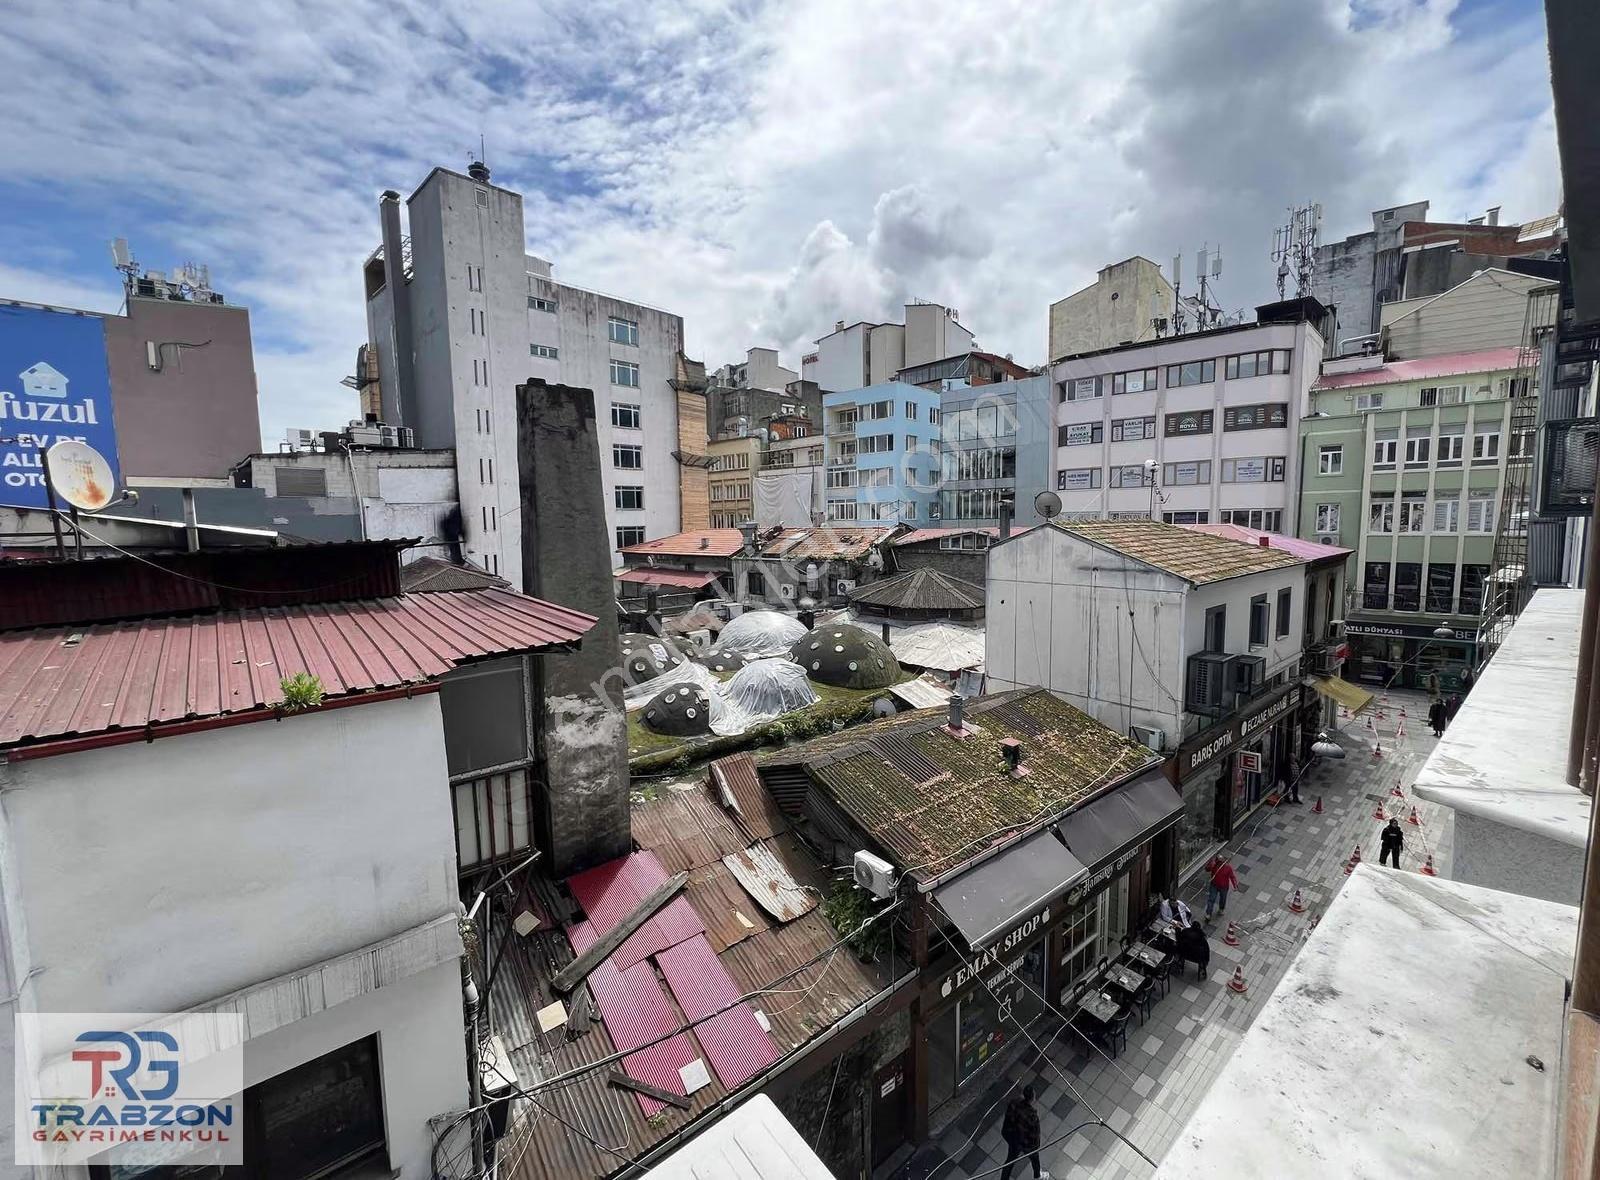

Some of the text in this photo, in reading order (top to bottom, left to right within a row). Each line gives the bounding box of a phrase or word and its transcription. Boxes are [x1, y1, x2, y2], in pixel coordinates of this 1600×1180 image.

[0, 391, 99, 424] fuzul
[17, 433, 48, 448] EV
[1364, 625, 1404, 635] DÜNYASI
[1247, 709, 1267, 732] ECZANE
[1191, 729, 1233, 768] BARIŞ OPTİK
[956, 915, 1040, 989] EMAY SHOP
